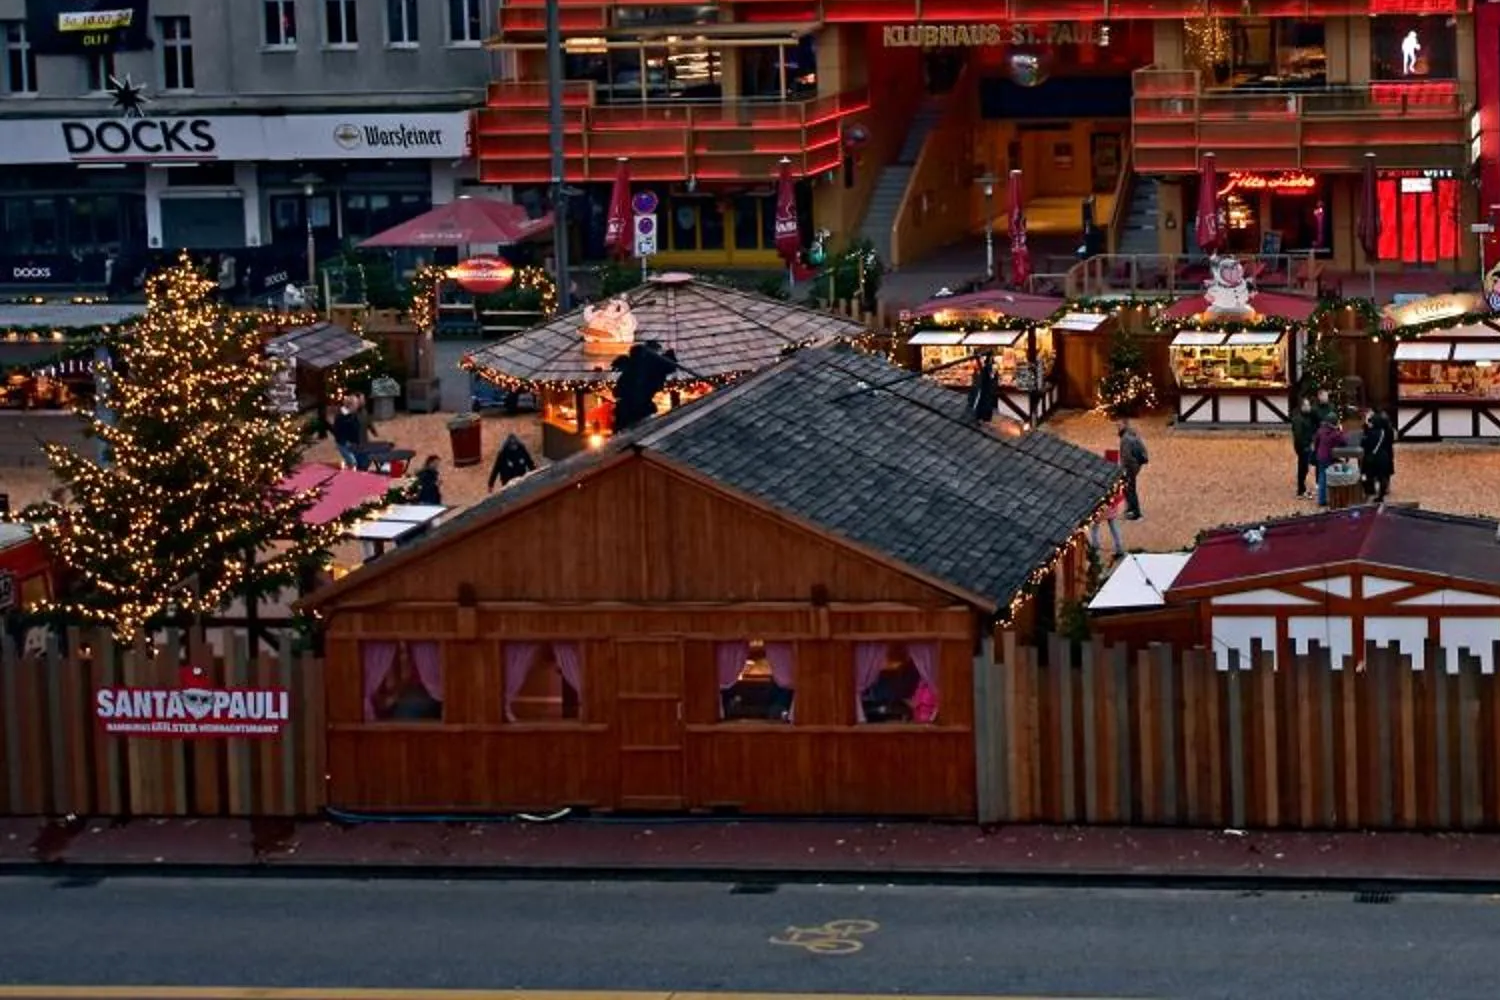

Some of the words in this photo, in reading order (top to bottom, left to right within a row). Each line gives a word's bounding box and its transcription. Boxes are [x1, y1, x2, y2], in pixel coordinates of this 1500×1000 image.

[883, 25, 1000, 47] KLUBHAUS
[1010, 24, 1041, 45] ST.
[62, 119, 216, 154] DOCKS
[364, 123, 442, 149] Warsteiner
[13, 267, 51, 278] DOCKS
[97, 688, 185, 719] SANTA
[213, 690, 289, 719] PAULI
